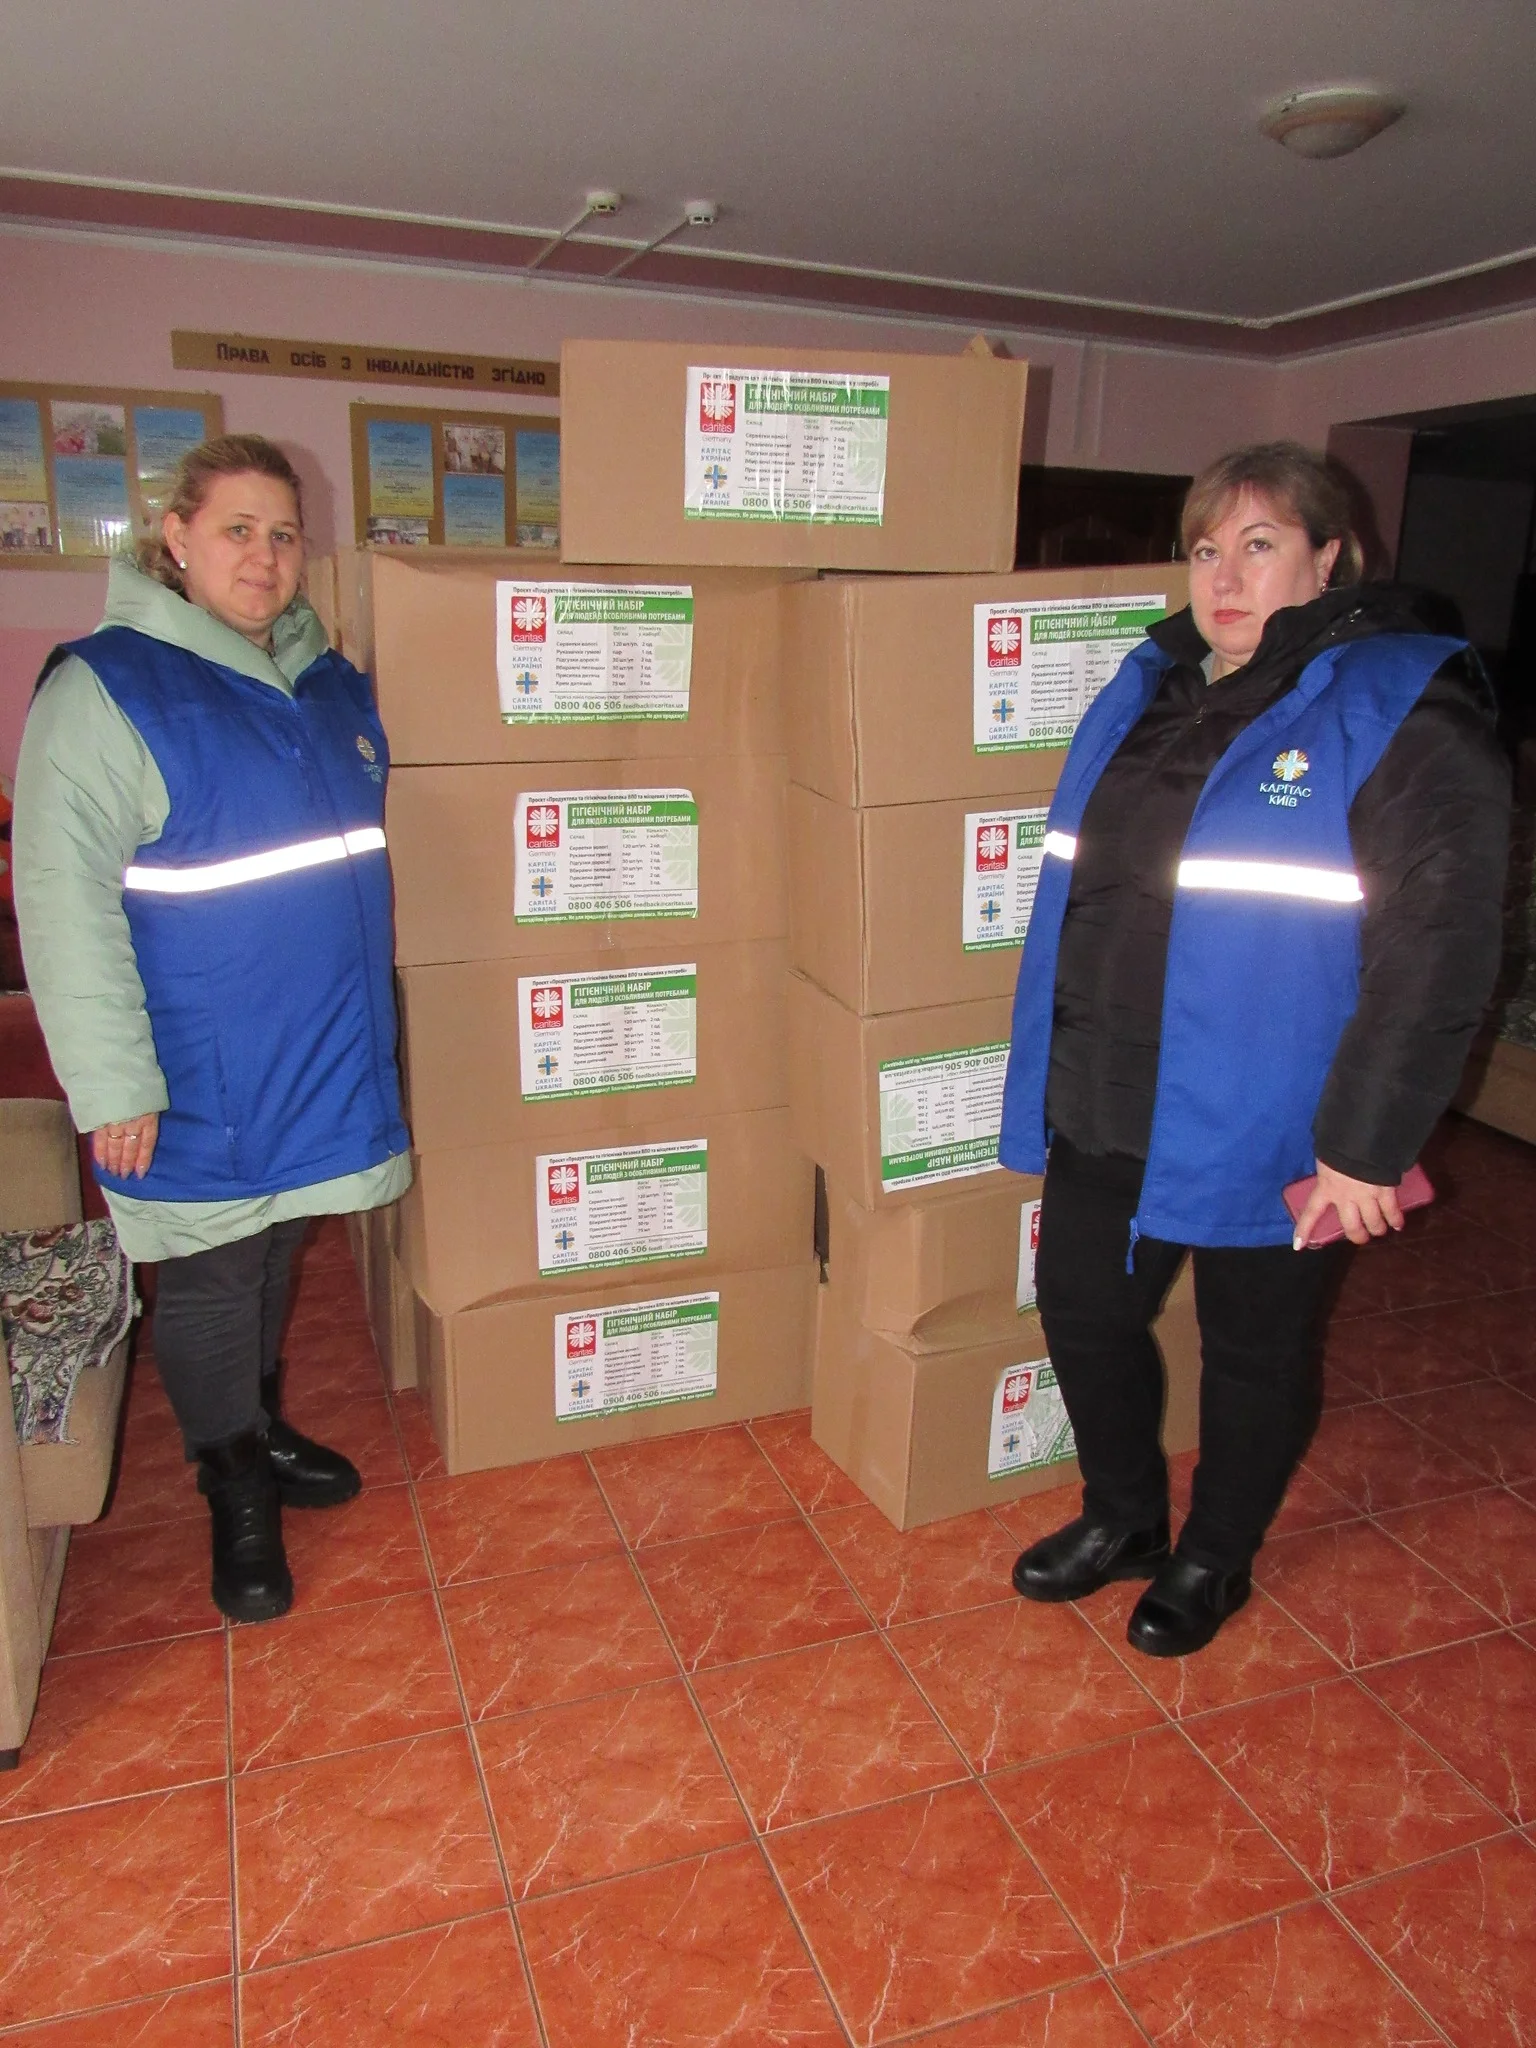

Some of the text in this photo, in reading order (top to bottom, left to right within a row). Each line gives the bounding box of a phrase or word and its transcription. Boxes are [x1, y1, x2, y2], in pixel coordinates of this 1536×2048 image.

[809, 391, 837, 403] НАБІР
[702, 422, 733, 433] caritas
[701, 447, 731, 455] КАРІТАС
[743, 497, 768, 508] 0800
[792, 499, 811, 509] 506
[617, 600, 645, 611] НАБІР
[1034, 615, 1117, 631] ГІГІЄНІЧНИЙ НАБІР
[513, 633, 544, 642] caritas
[990, 656, 1019, 667] caritas
[989, 681, 1018, 690] КАРІТАС
[554, 701, 621, 710] 0800 406 506
[989, 725, 1018, 733] CARITAS
[1029, 725, 1073, 737] 0800 406
[989, 732, 1018, 740] UKRAINE
[1260, 783, 1311, 797] КАРІТАС
[1269, 795, 1297, 807] КИЇВ
[571, 805, 652, 817] ГІГІЄНІЧНИЙ НАБІР
[529, 839, 557, 848] caritas
[978, 861, 1006, 872] caritas
[977, 884, 1005, 892] КАРІТАС
[568, 900, 632, 910] 0800 406 506
[977, 924, 1004, 932] CARITAS
[977, 931, 1004, 939] UKRAINE
[574, 981, 652, 997] ГІГІЄНІЧНИЙ НАБІР
[534, 1019, 561, 1029] caritas
[534, 1040, 561, 1048] КАРІТАС
[945, 1053, 1005, 1072] 0800 406 506
[573, 1072, 634, 1086] 0800 406 506
[535, 1083, 563, 1091] UKRAINE
[590, 1157, 664, 1174] ГІГІЄНІЧНИЙ НАБІР
[927, 1155, 951, 1169] НАБІР
[551, 1215, 577, 1224] КАРІТАС
[552, 1251, 578, 1259] CARITAS
[589, 1245, 647, 1260] 0800 406 506
[552, 1257, 579, 1265] UKRAINE
[655, 1309, 677, 1320] НАБІР
[626, 1392, 642, 1402] 406
[644, 1389, 659, 1399] 506
